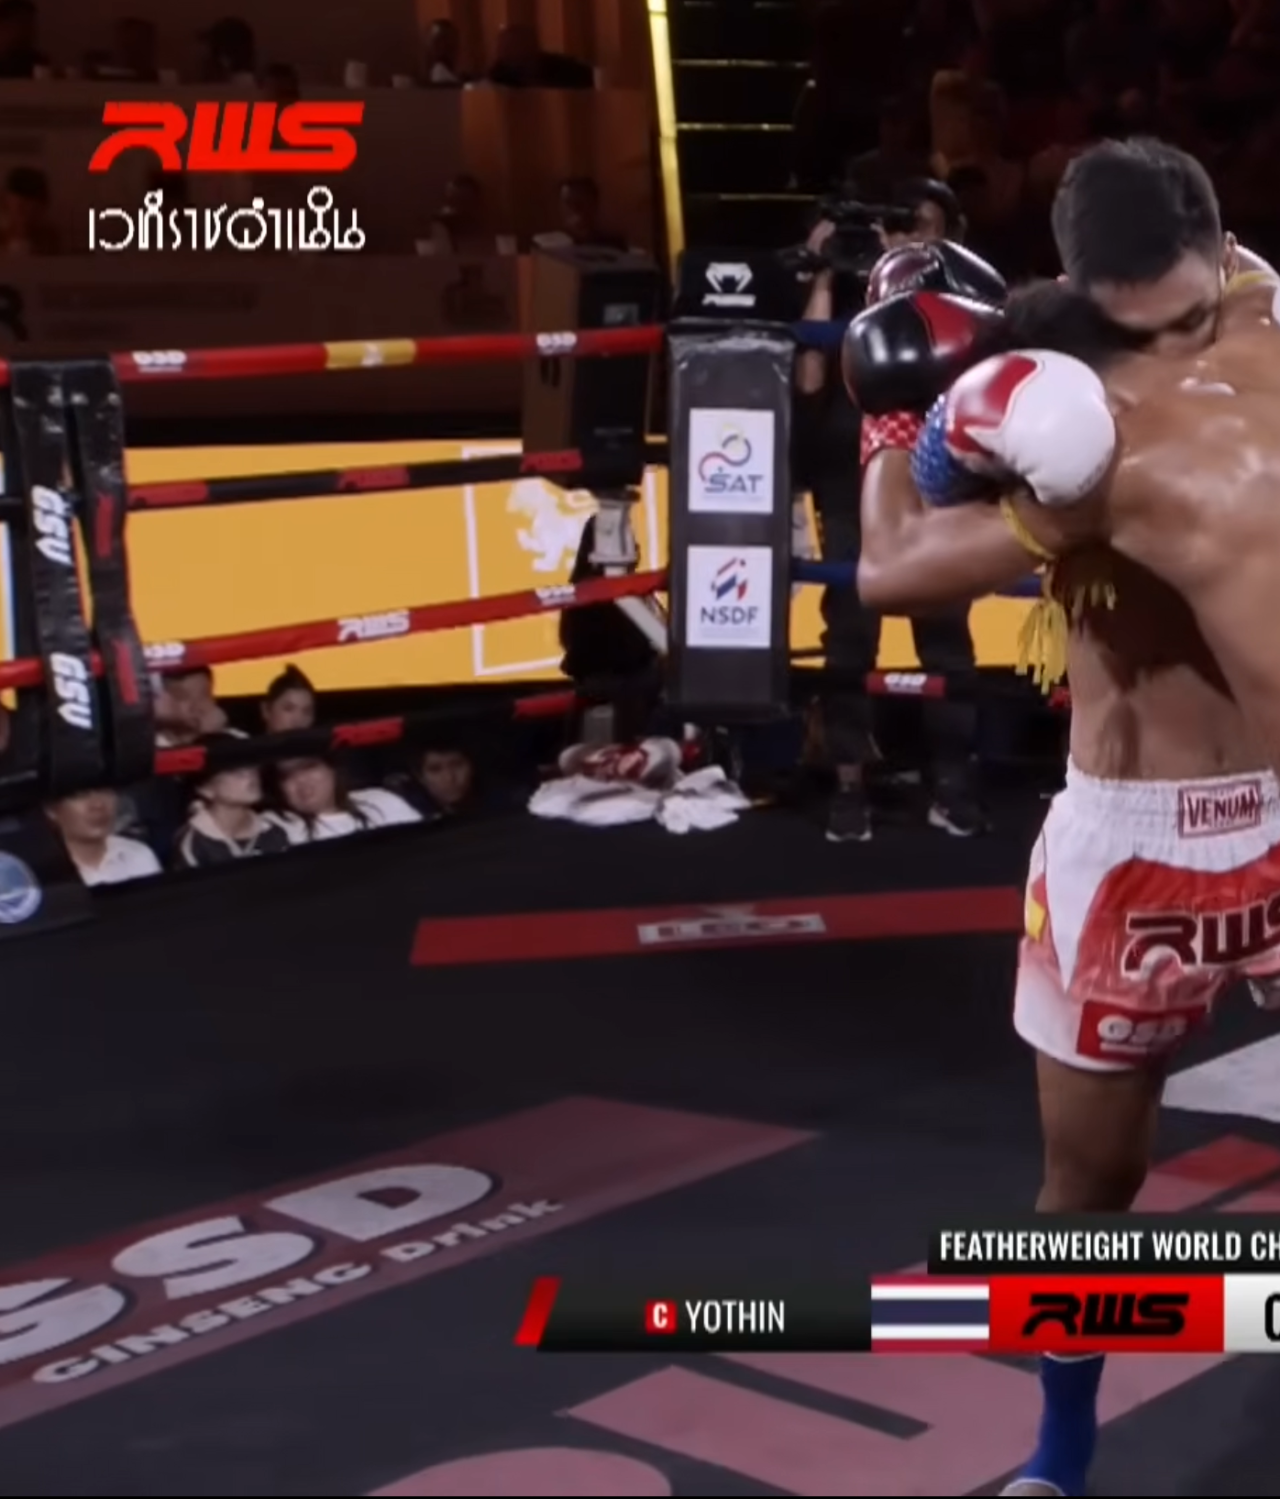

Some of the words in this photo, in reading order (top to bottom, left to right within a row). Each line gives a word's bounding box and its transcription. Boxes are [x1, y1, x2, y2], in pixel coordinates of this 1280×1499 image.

[704, 474, 764, 494] SAT
[700, 606, 759, 625] NSDF
[1186, 790, 1256, 829] VENUM
[31, 1263, 372, 1383] GINSENG
[380, 1199, 564, 1263] Drink
